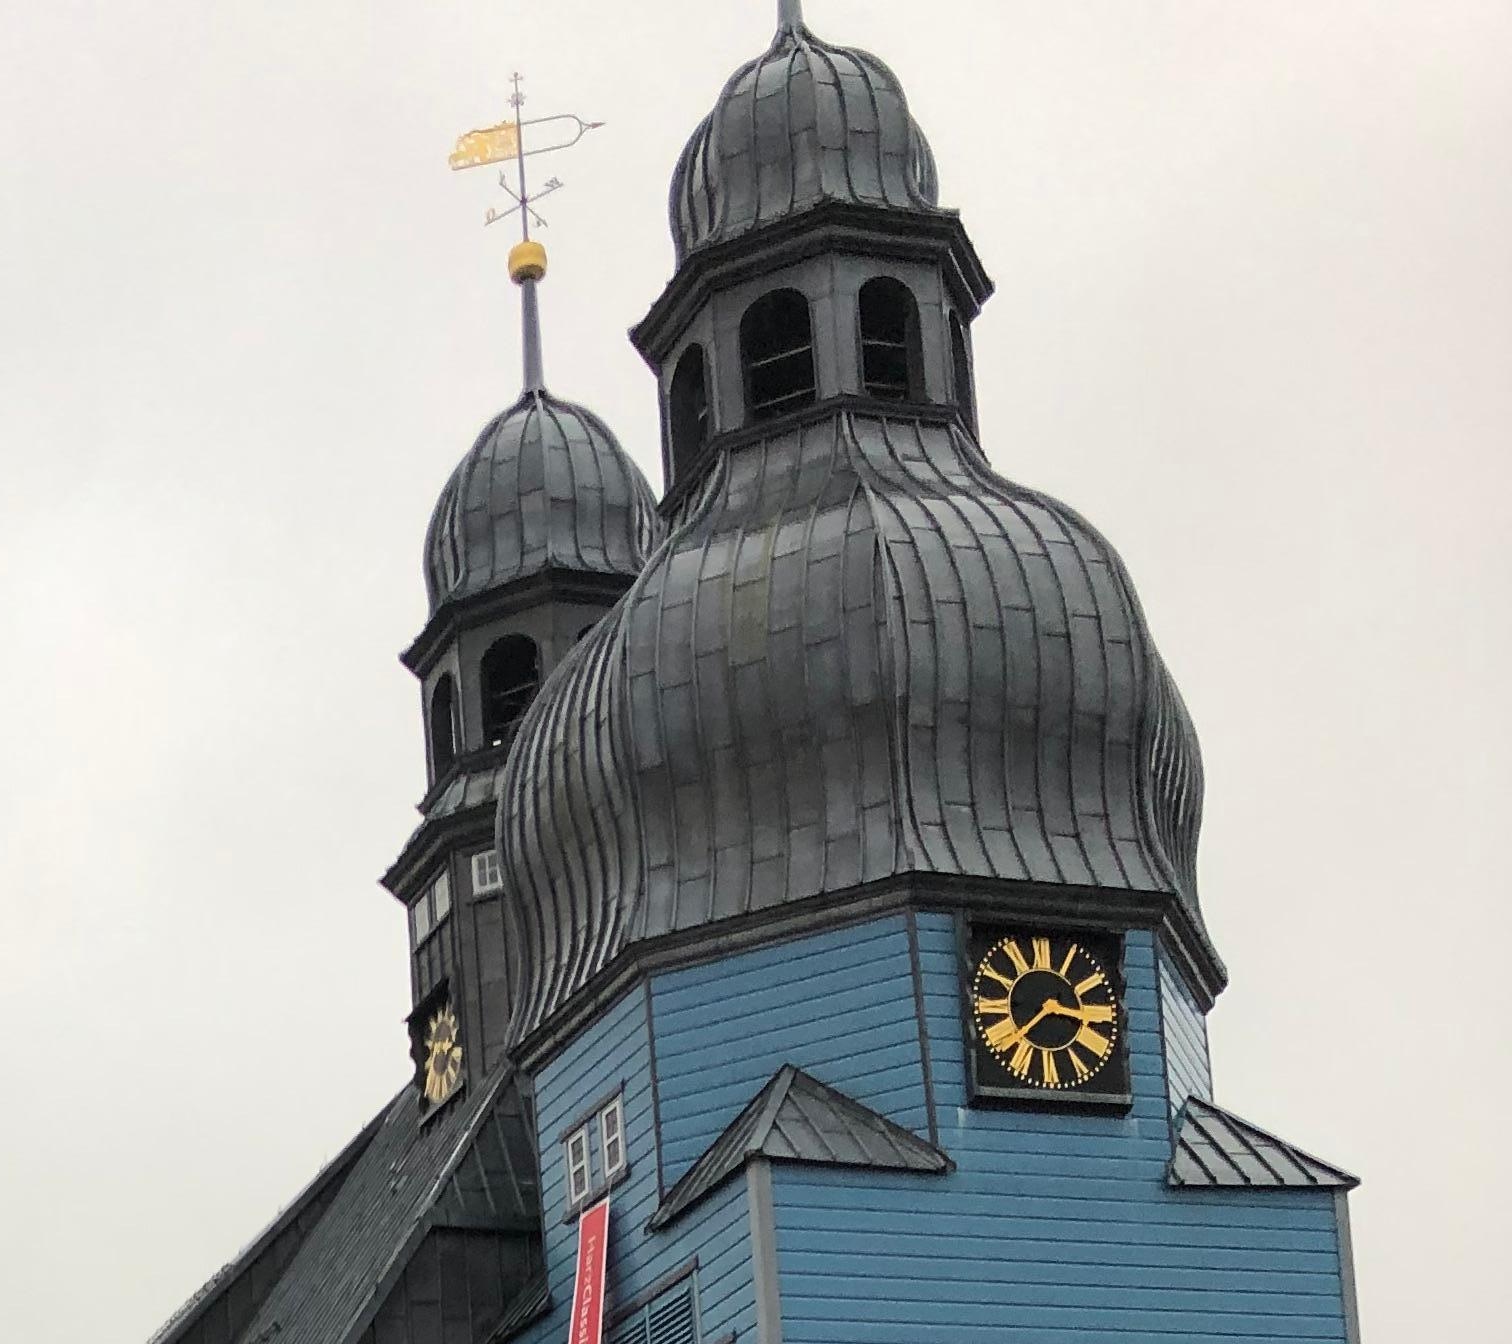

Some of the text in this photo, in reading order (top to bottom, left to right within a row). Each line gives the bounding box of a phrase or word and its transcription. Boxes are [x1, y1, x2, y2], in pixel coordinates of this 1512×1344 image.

[1003, 940, 1029, 976] XI
[1032, 937, 1051, 969] XII
[1059, 943, 1078, 976] I
[983, 963, 1014, 990] X
[978, 995, 1009, 1014] IX
[1042, 1050, 1060, 1083] VI
[1067, 1046, 1090, 1078] V
